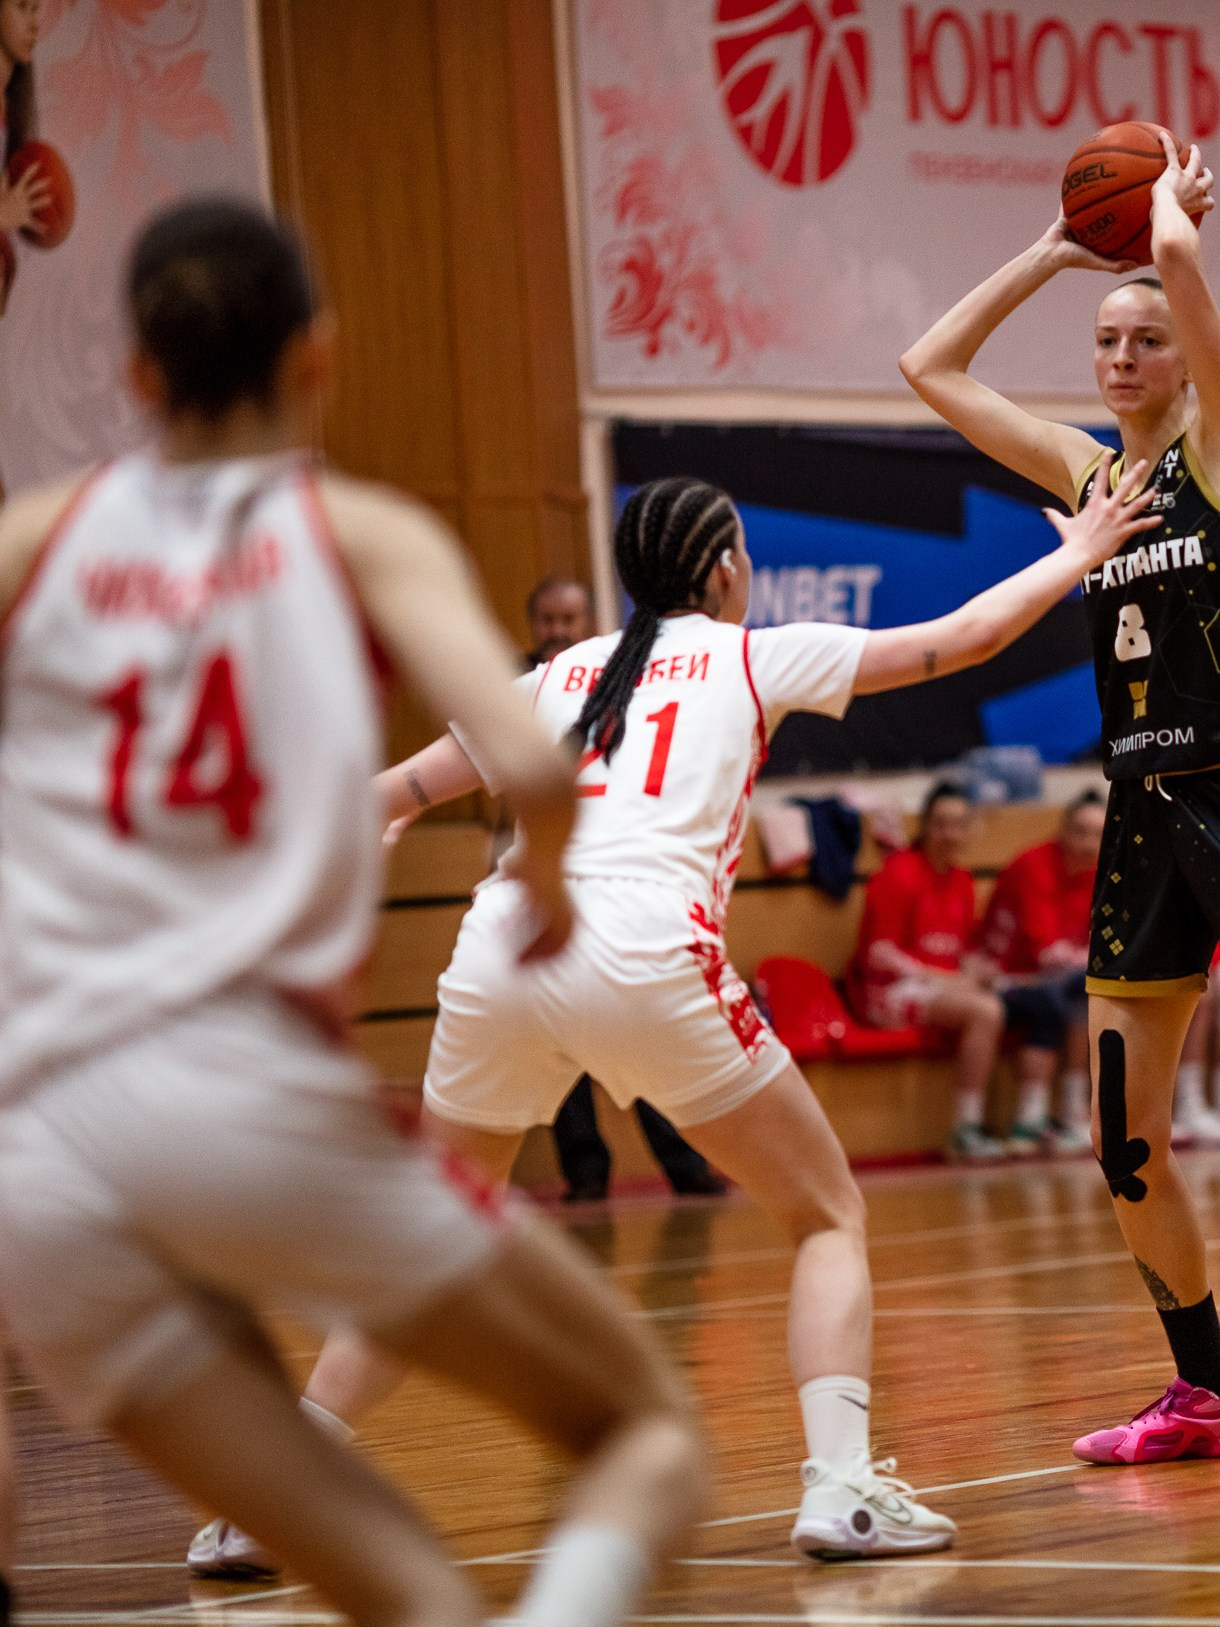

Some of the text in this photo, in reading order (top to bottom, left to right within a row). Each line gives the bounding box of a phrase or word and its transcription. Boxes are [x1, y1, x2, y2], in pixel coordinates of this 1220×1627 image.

[1115, 603, 1151, 662] 8
[98, 652, 264, 838] 14
[1109, 726, 1195, 756] ХИМПРОМ
